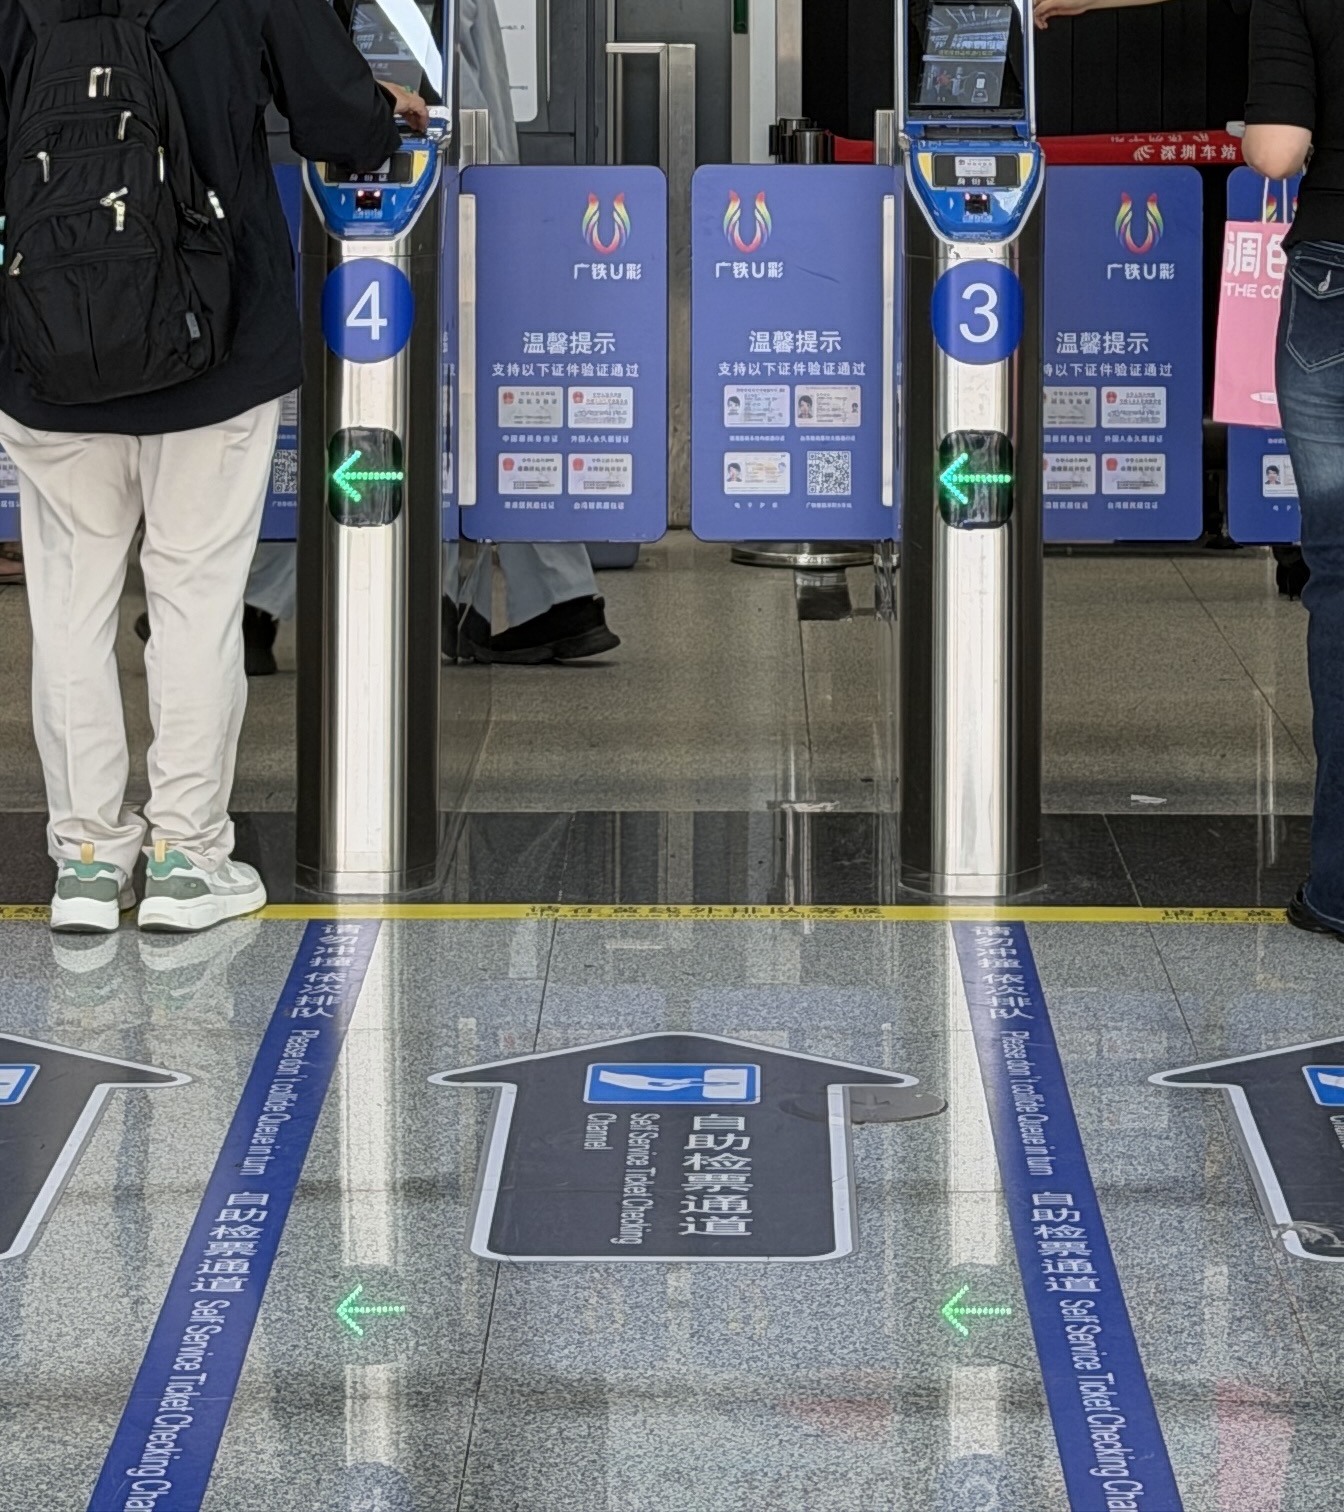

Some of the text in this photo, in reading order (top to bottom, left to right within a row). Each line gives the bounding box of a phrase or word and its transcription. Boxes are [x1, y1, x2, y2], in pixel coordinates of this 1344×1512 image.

[1160, 144, 1237, 162] 深圳车站
[573, 262, 642, 280] 广铁U彩
[715, 261, 784, 279] 广铁U彩
[1106, 263, 1175, 280] 广铁U彩
[1224, 283, 1257, 298] THE
[346, 281, 388, 340] 4
[959, 282, 999, 343] 3
[523, 331, 616, 355] 温馨提示
[749, 330, 842, 354] 温馨提示
[1056, 331, 1149, 354] 温馨提示
[491, 362, 639, 378] 支持以下证件验证通过
[718, 361, 866, 377] 支持以下证件验证通过
[281, 1029, 321, 1057] Please
[261, 1083, 303, 1111] collide
[247, 1113, 293, 1142] Queue
[581, 1113, 616, 1149] Channel
[237, 1156, 277, 1175] turn
[609, 1113, 660, 1244] Self Service Ticket Checking
[678, 1113, 751, 1235] 自助检票通道
[187, 1192, 274, 1292] 自助检票通道
[1023, 1192, 1102, 1291] 自助检票通道
[122, 1299, 233, 1476] Self Service Ticket Checking
